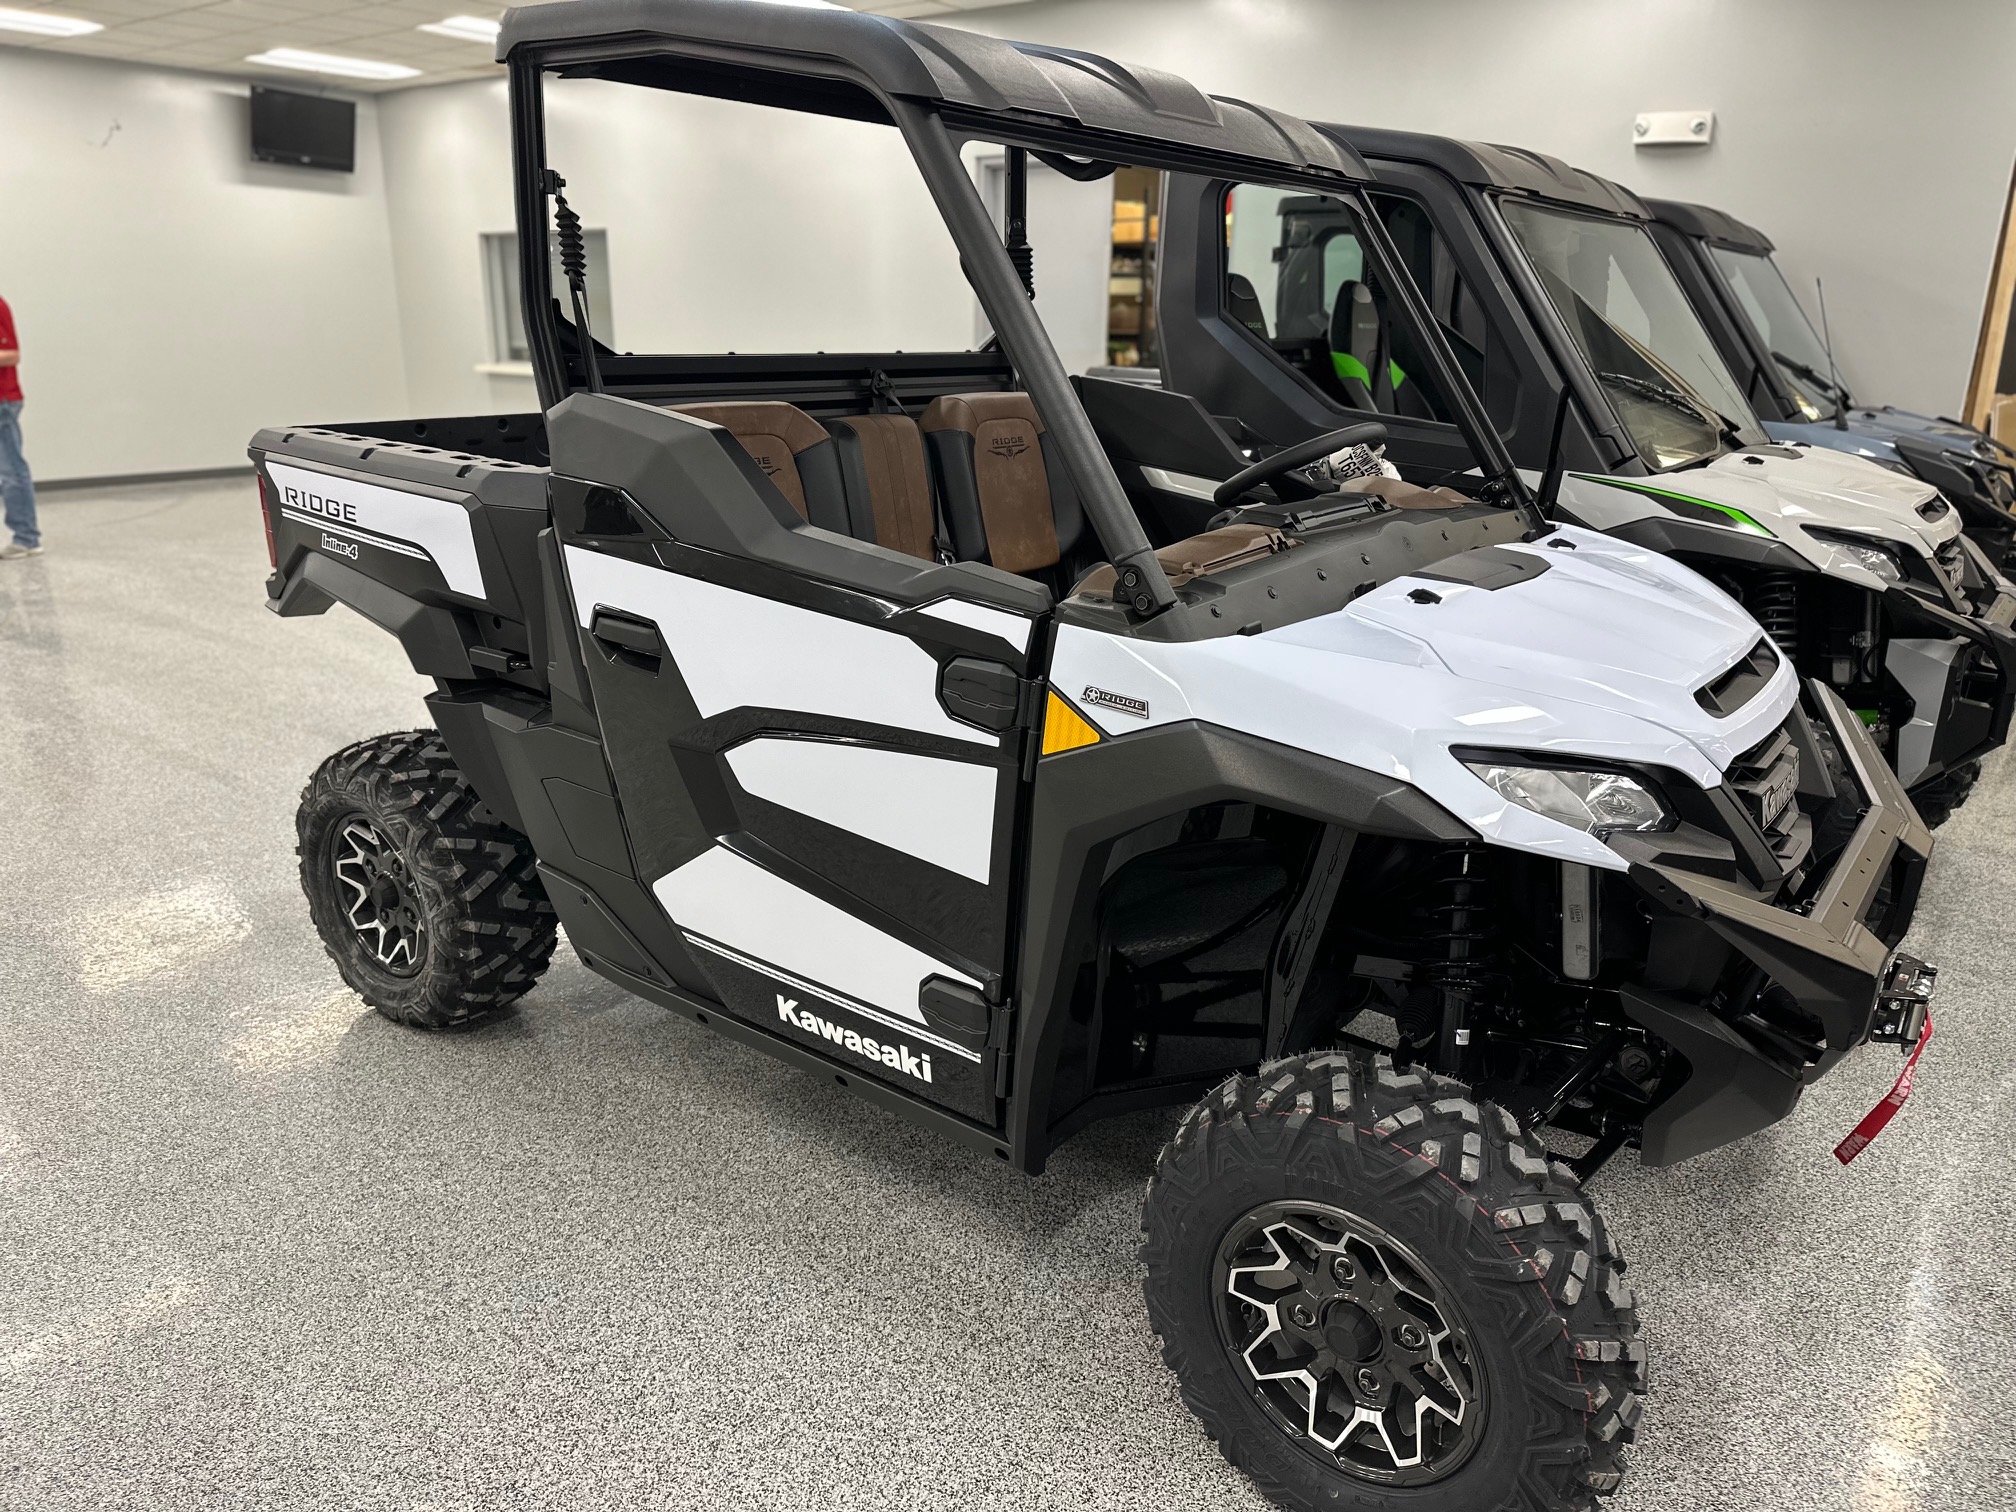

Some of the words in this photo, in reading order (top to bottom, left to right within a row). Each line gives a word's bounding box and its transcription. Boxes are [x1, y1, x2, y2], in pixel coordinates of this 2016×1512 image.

[992, 436, 1024, 446] RIDGE
[285, 486, 358, 523] RIDGE
[321, 532, 358, 560] Inline-4
[1101, 693, 1144, 709] RIDGE
[776, 993, 932, 1083] Kawasaki
[1838, 1132, 1870, 1161] WARN
